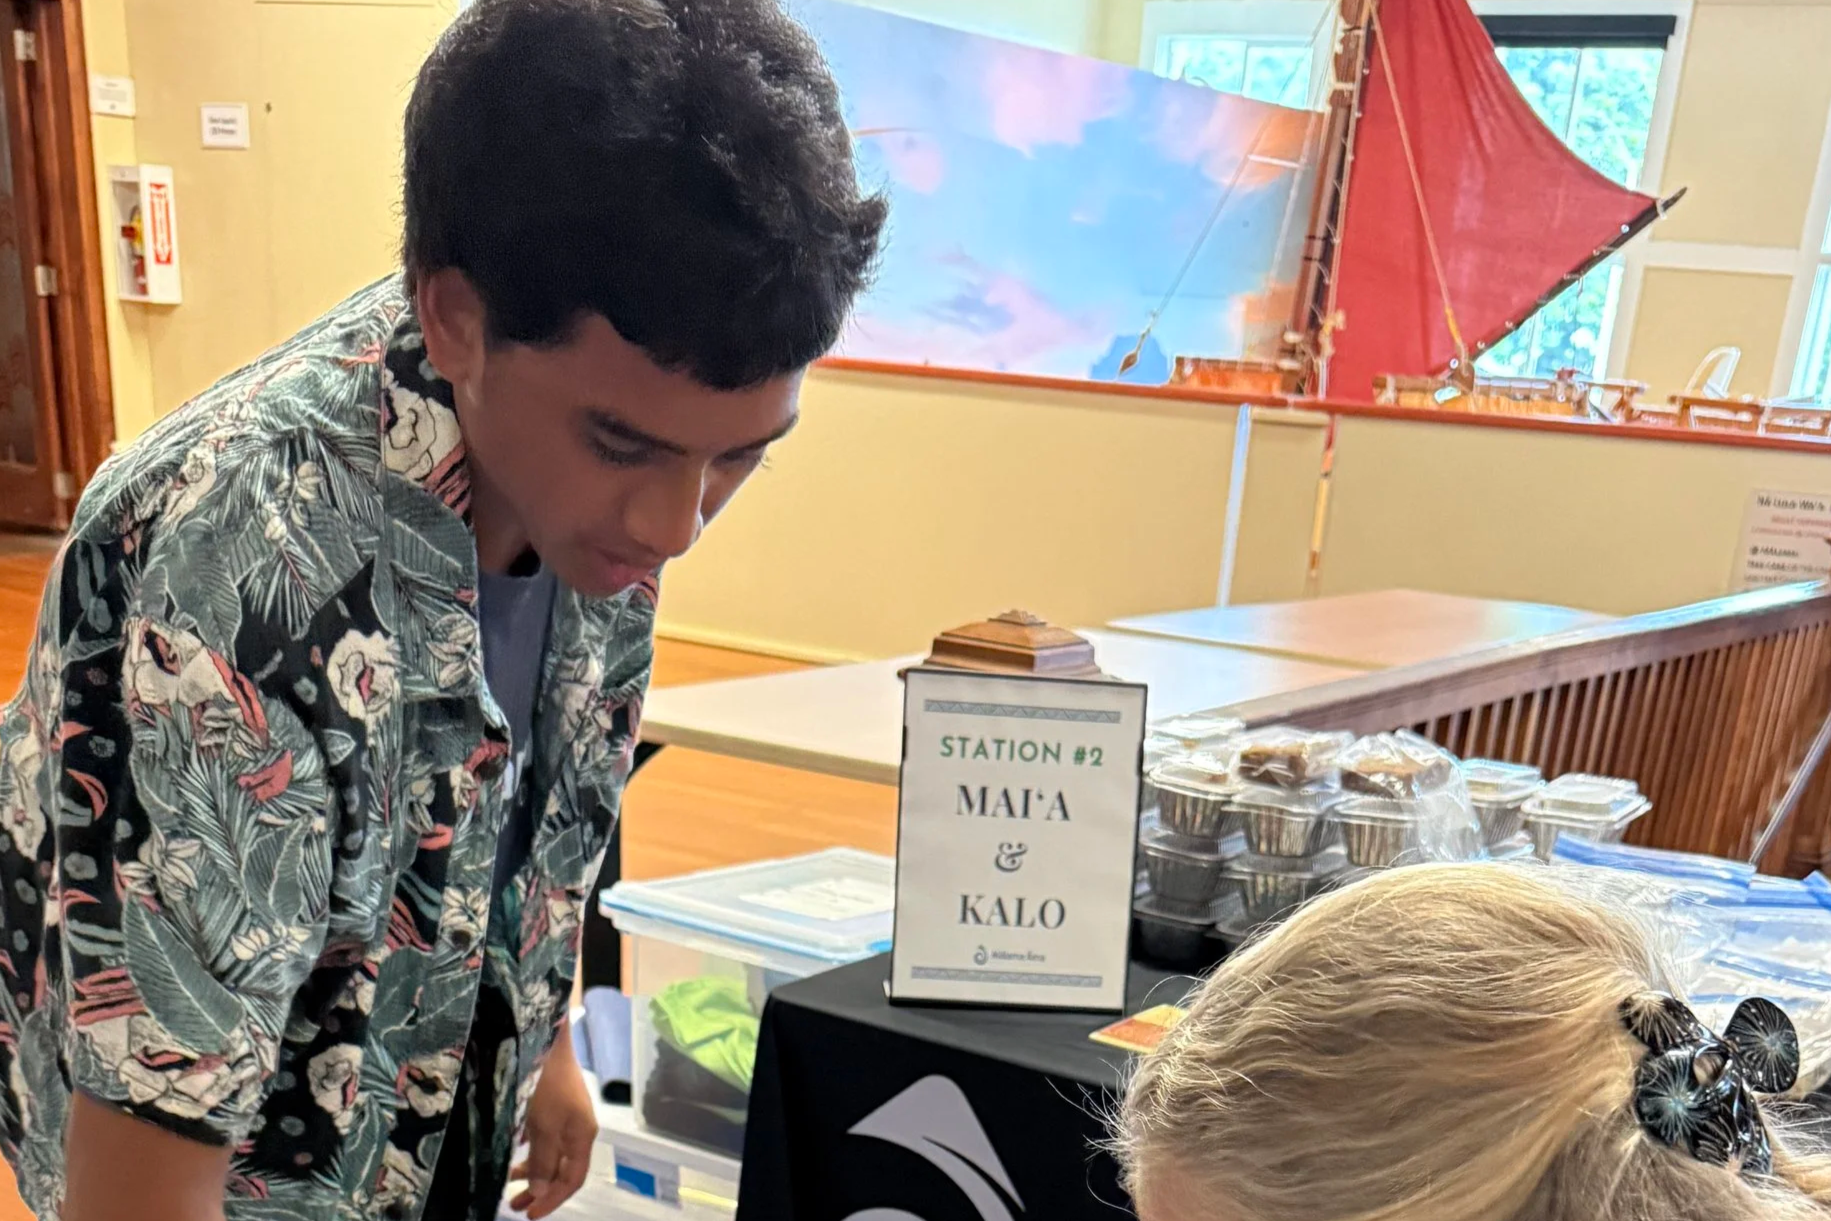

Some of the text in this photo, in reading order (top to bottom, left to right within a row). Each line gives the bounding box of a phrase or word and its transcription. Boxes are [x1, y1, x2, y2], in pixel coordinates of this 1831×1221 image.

[939, 735, 1104, 767] STATION #2
[994, 842, 1027, 873] &
[958, 894, 1067, 929] KALO
